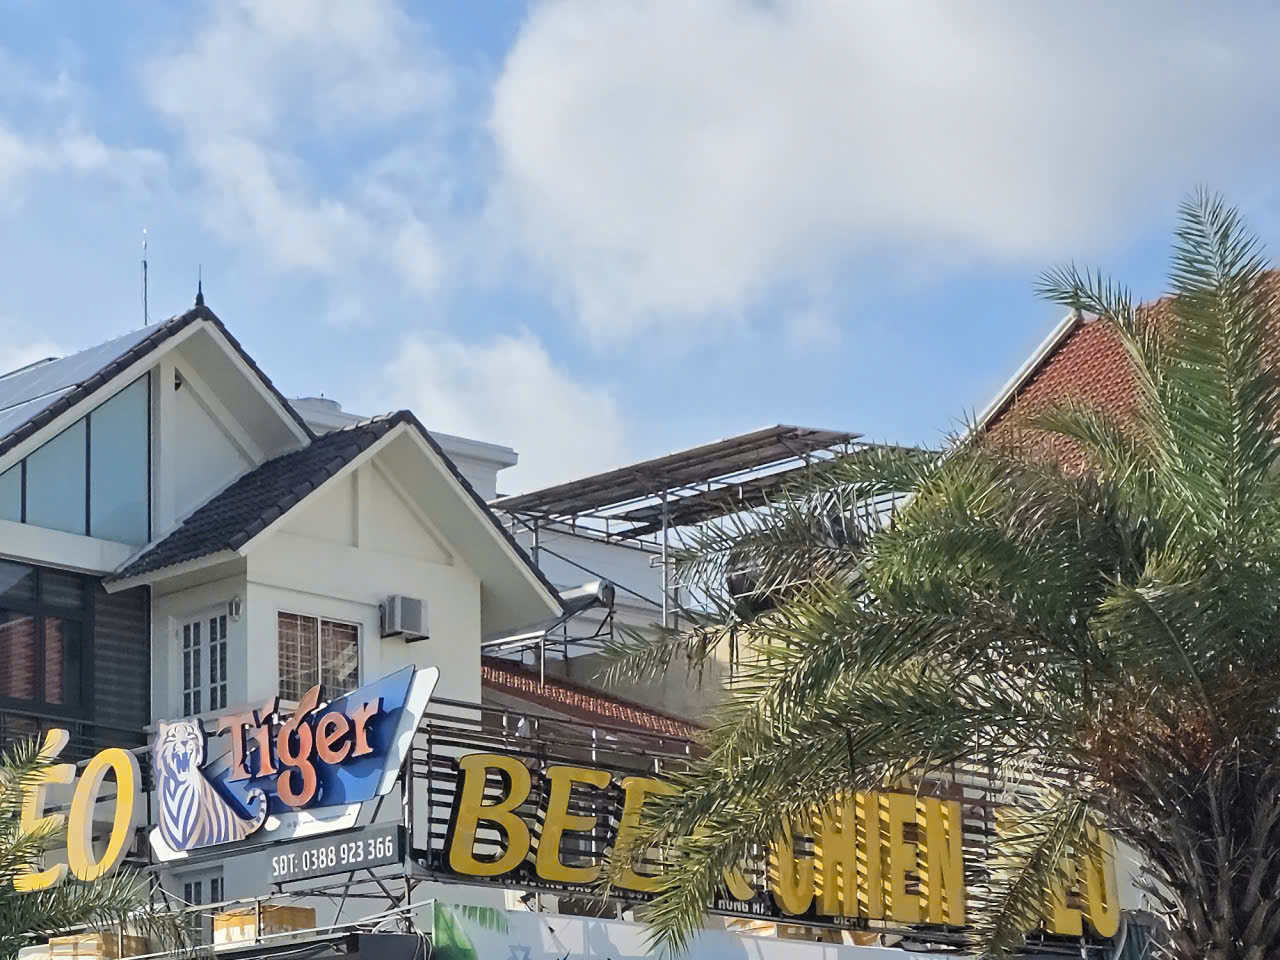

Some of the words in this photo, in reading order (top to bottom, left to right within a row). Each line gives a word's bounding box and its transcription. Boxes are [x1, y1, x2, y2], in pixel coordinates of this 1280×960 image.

[218, 685, 385, 808] Tiger
[271, 851, 299, 877] SĐT:
[302, 848, 336, 871] 0388
[340, 841, 365, 865] 923
[367, 835, 394, 860] 366
[448, 752, 756, 902] BEE
